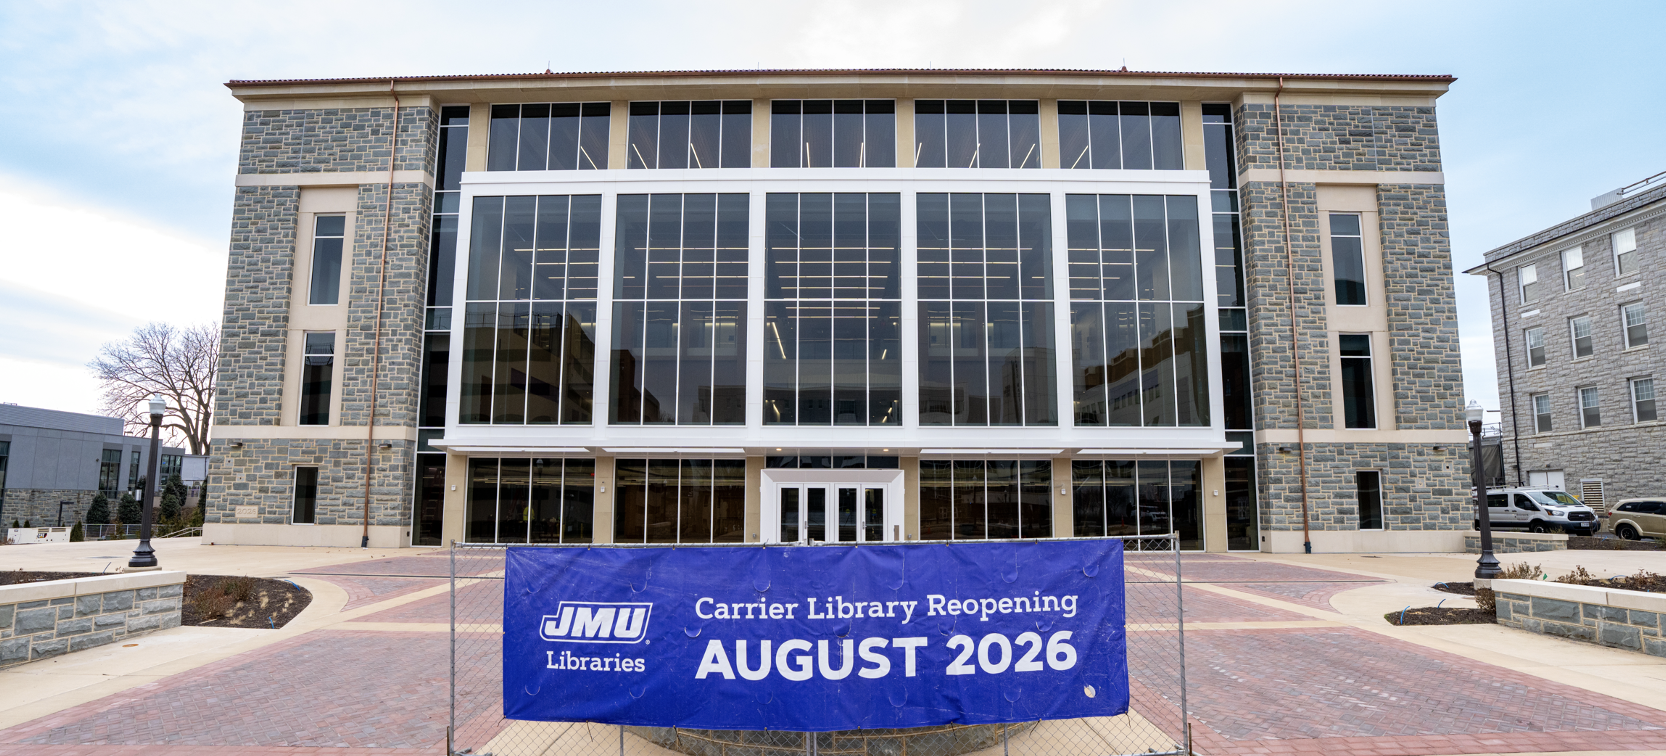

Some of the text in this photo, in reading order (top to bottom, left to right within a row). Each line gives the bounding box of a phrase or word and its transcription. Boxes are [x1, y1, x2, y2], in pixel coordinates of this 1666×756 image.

[544, 606, 647, 638] JMU
[695, 590, 1079, 625] Carrier Library Reopening
[546, 650, 646, 672] Libraries
[694, 630, 1078, 682] AUGUST 2026
